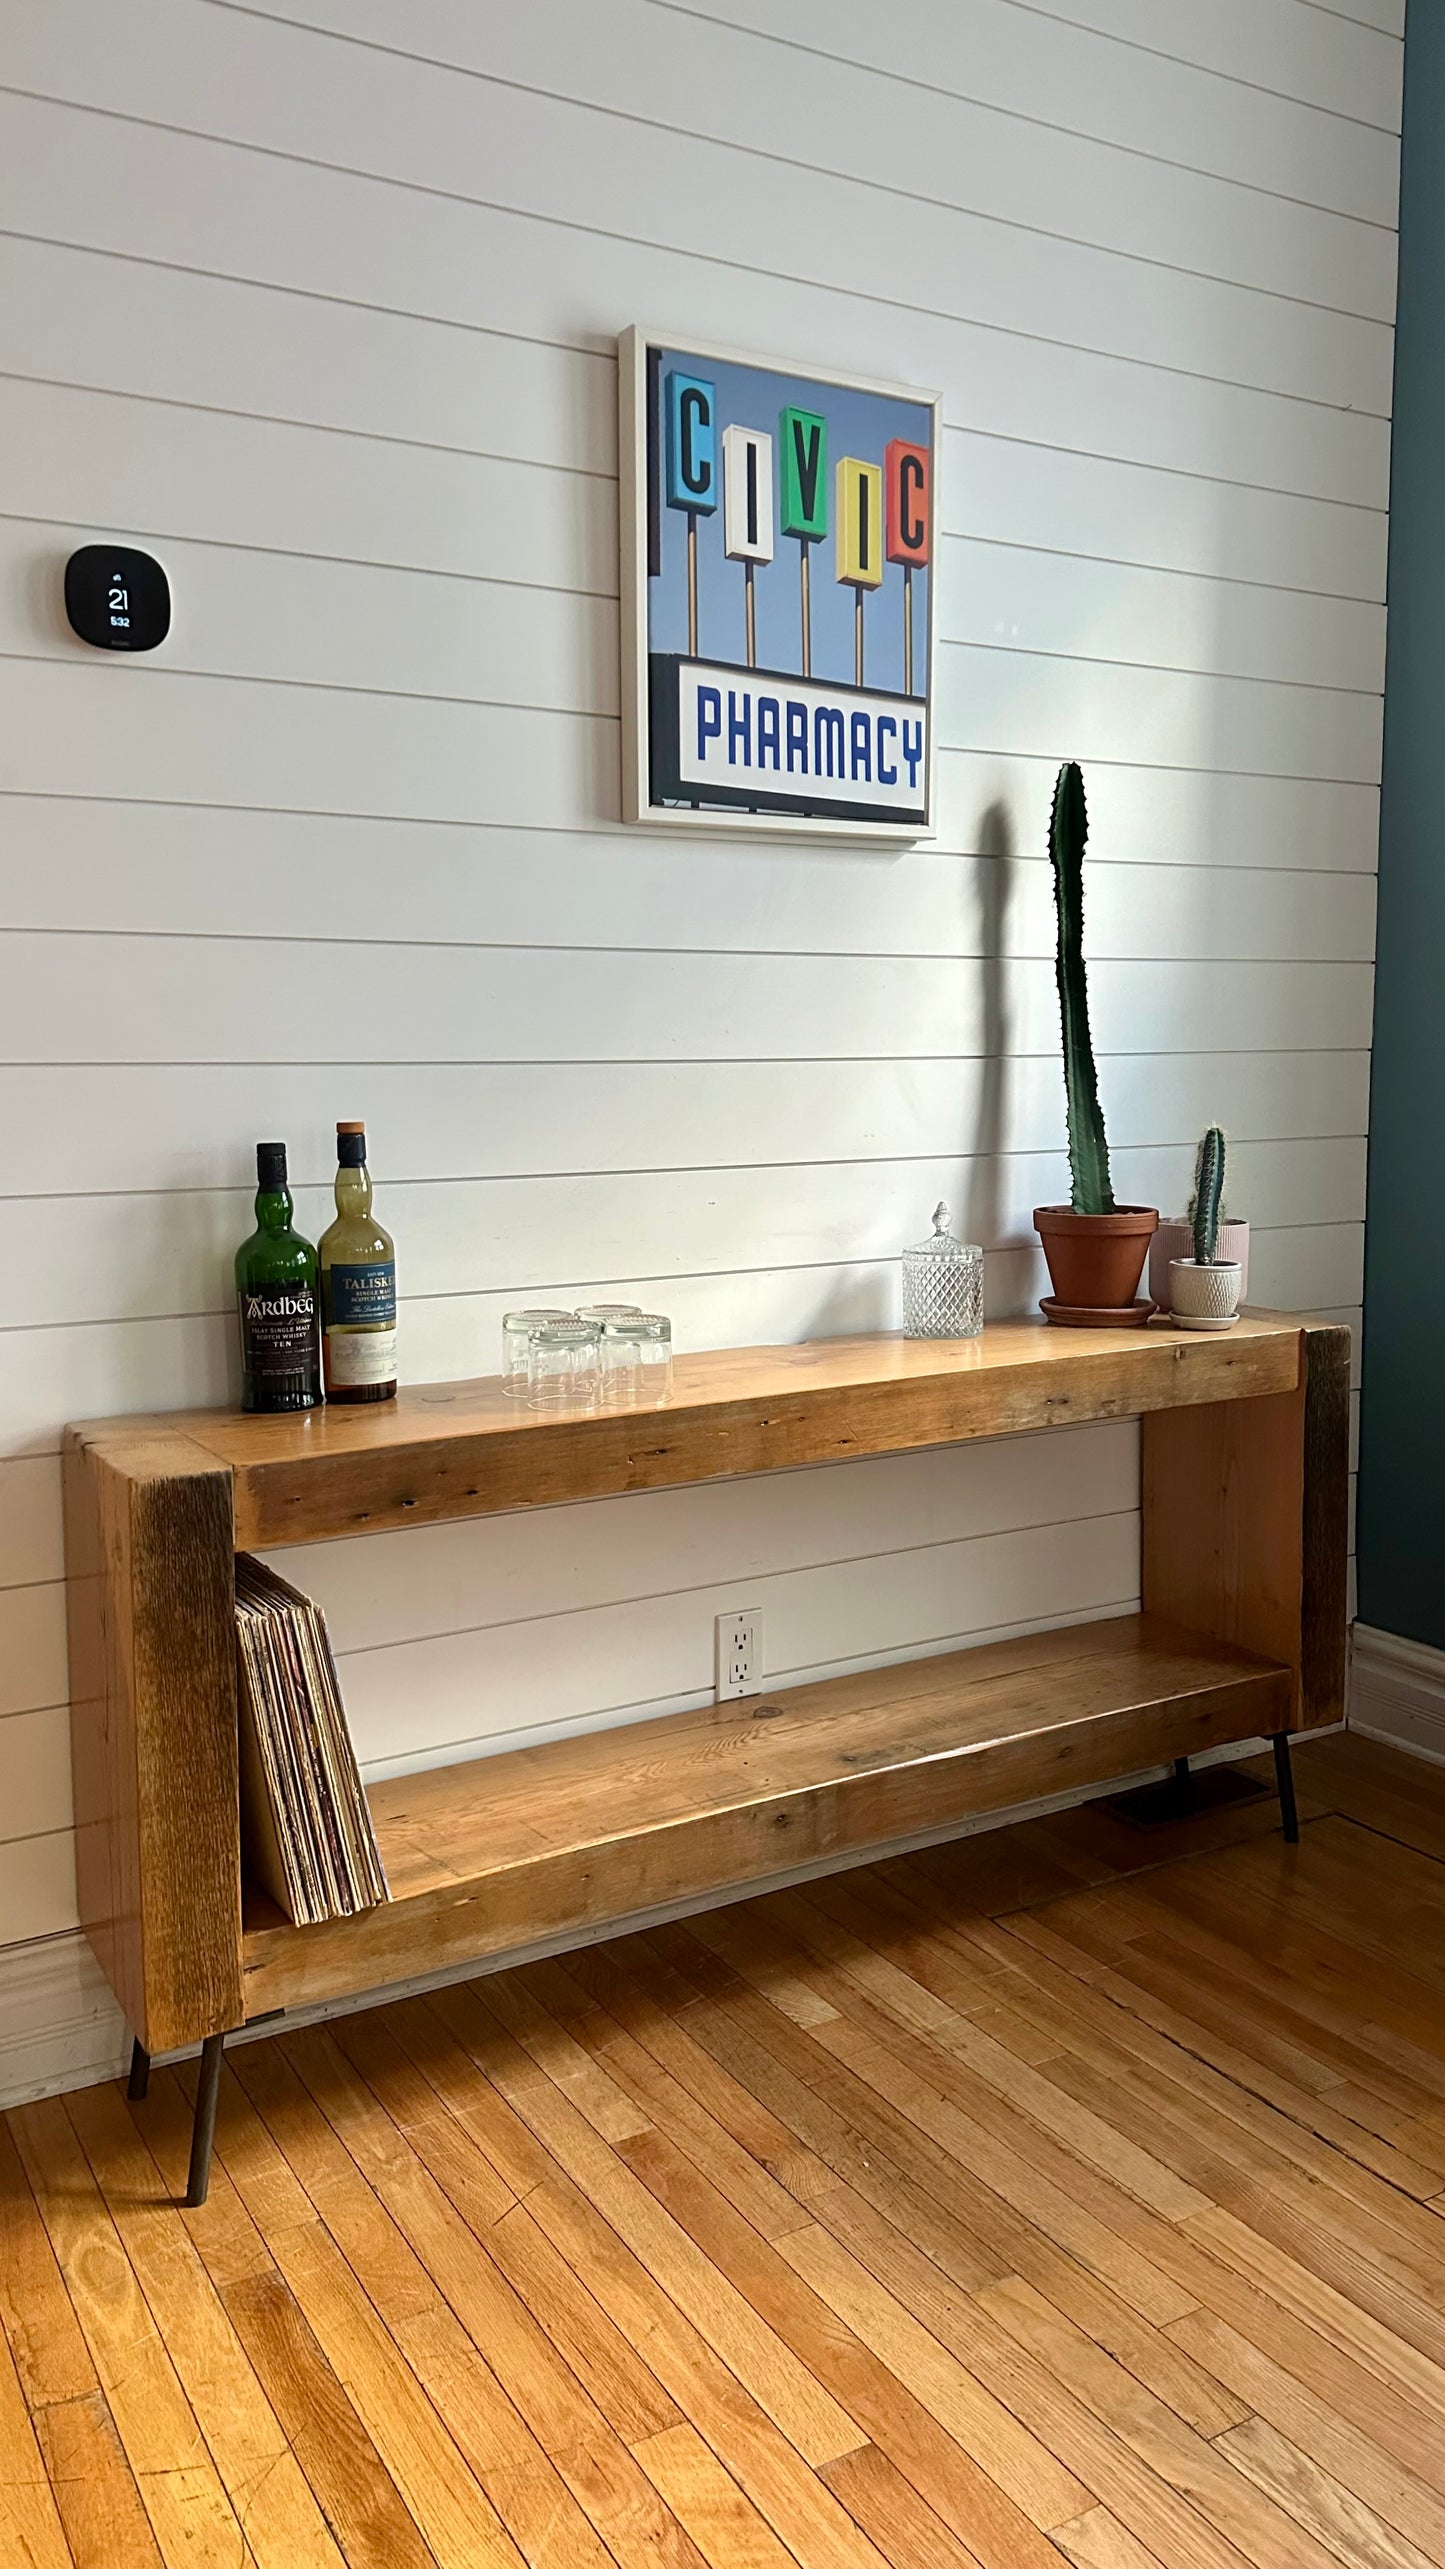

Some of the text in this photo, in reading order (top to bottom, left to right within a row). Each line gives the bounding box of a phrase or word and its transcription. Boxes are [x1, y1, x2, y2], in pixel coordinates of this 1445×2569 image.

[680, 387, 924, 570] CIVIC
[108, 588, 128, 610] 21
[697, 685, 923, 788] PHARMACY
[342, 1275, 395, 1289] TALISKE
[295, 1324, 311, 1332] MALT
